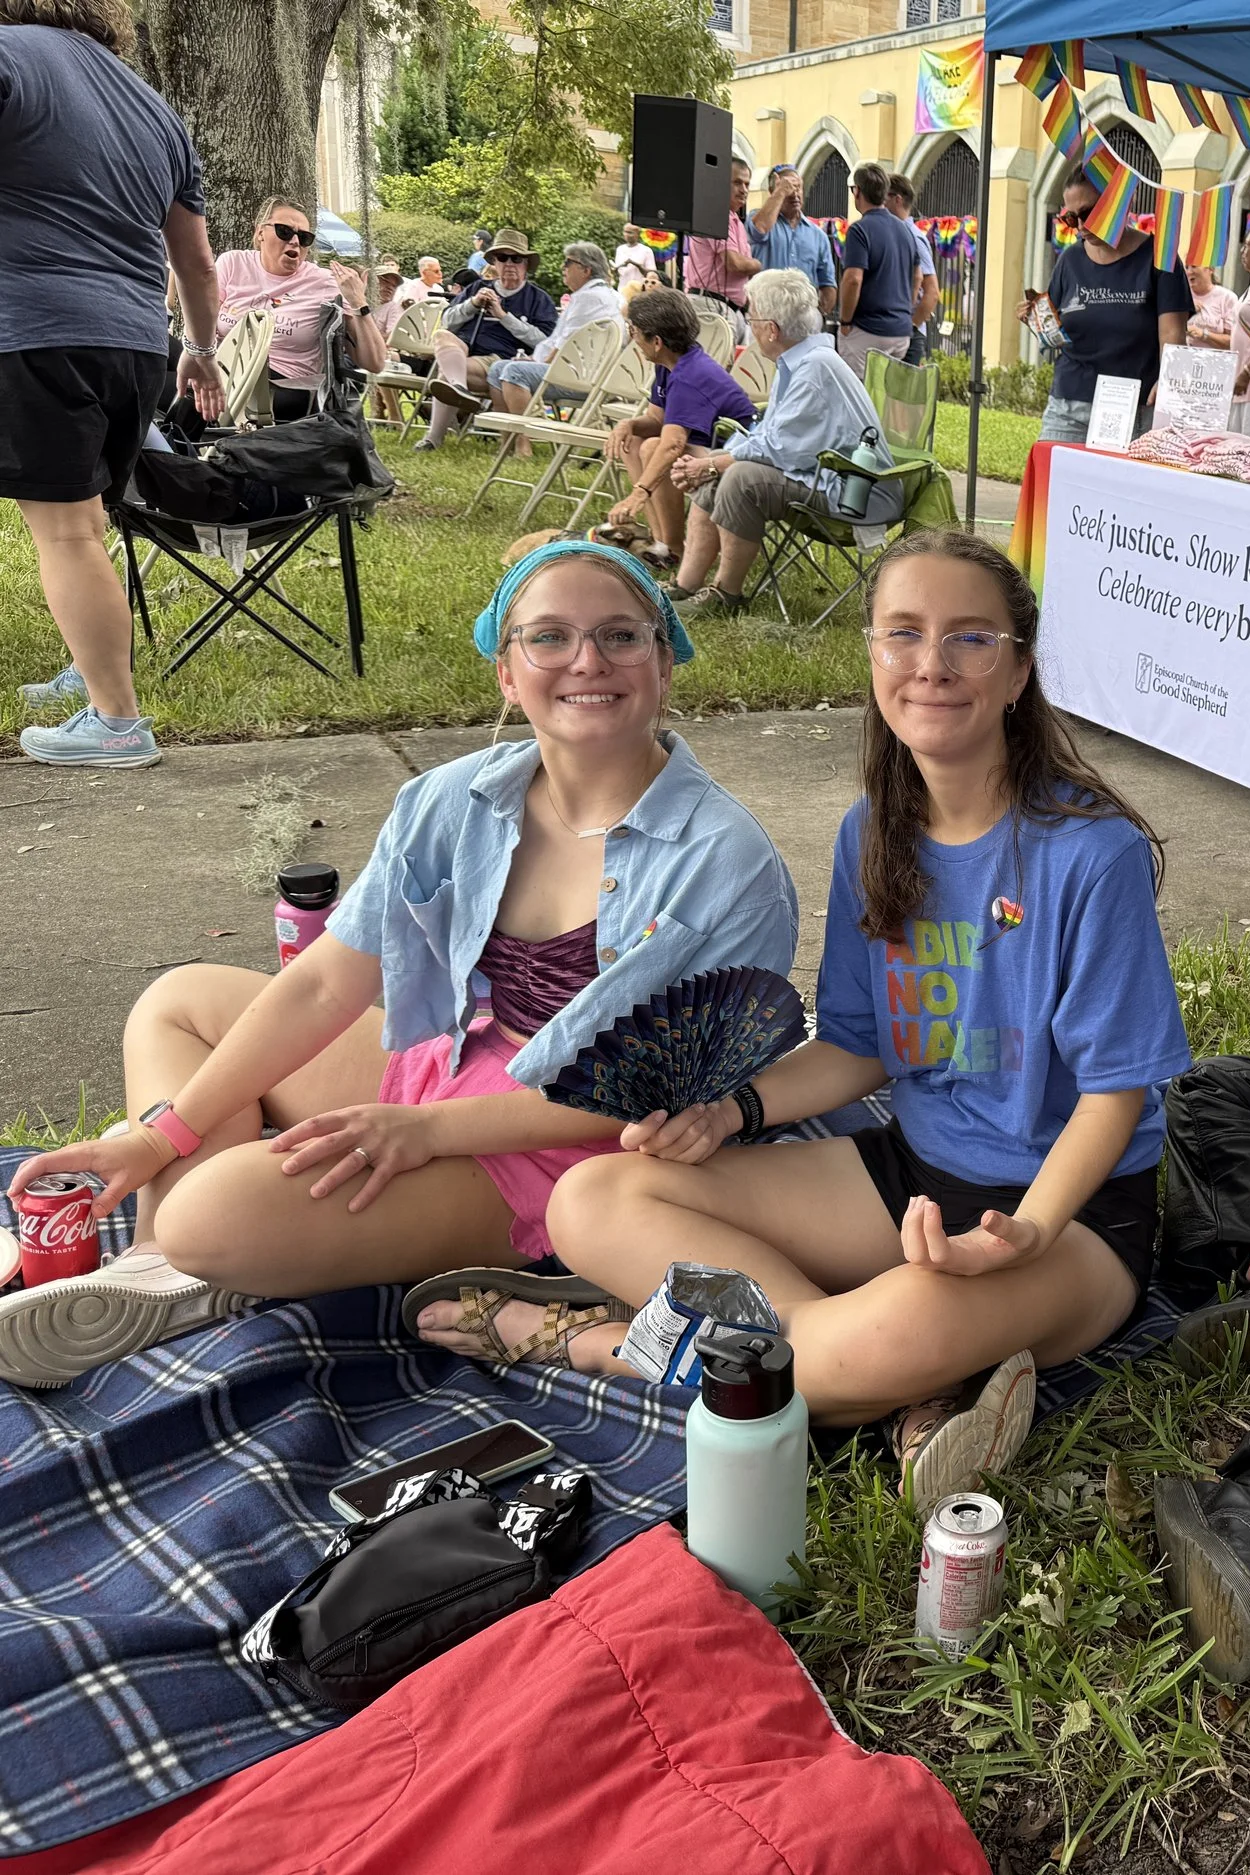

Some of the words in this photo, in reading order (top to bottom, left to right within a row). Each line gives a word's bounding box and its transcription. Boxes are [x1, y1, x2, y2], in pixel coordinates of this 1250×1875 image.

[1190, 380, 1224, 392] FORUM
[1069, 505, 1107, 543] Seek
[1108, 514, 1179, 562] justice.
[1186, 534, 1240, 578] Show
[1098, 566, 1182, 618] Celebrate
[1153, 677, 1180, 699] Good
[1180, 687, 1227, 717] Shepherd
[1154, 664, 1185, 683] Episcopal
[1186, 675, 1209, 692] Church
[1210, 684, 1218, 695] of
[1217, 687, 1229, 699] the
[887, 971, 959, 1016] NO
[52, 1246, 77, 1254] TASTE
